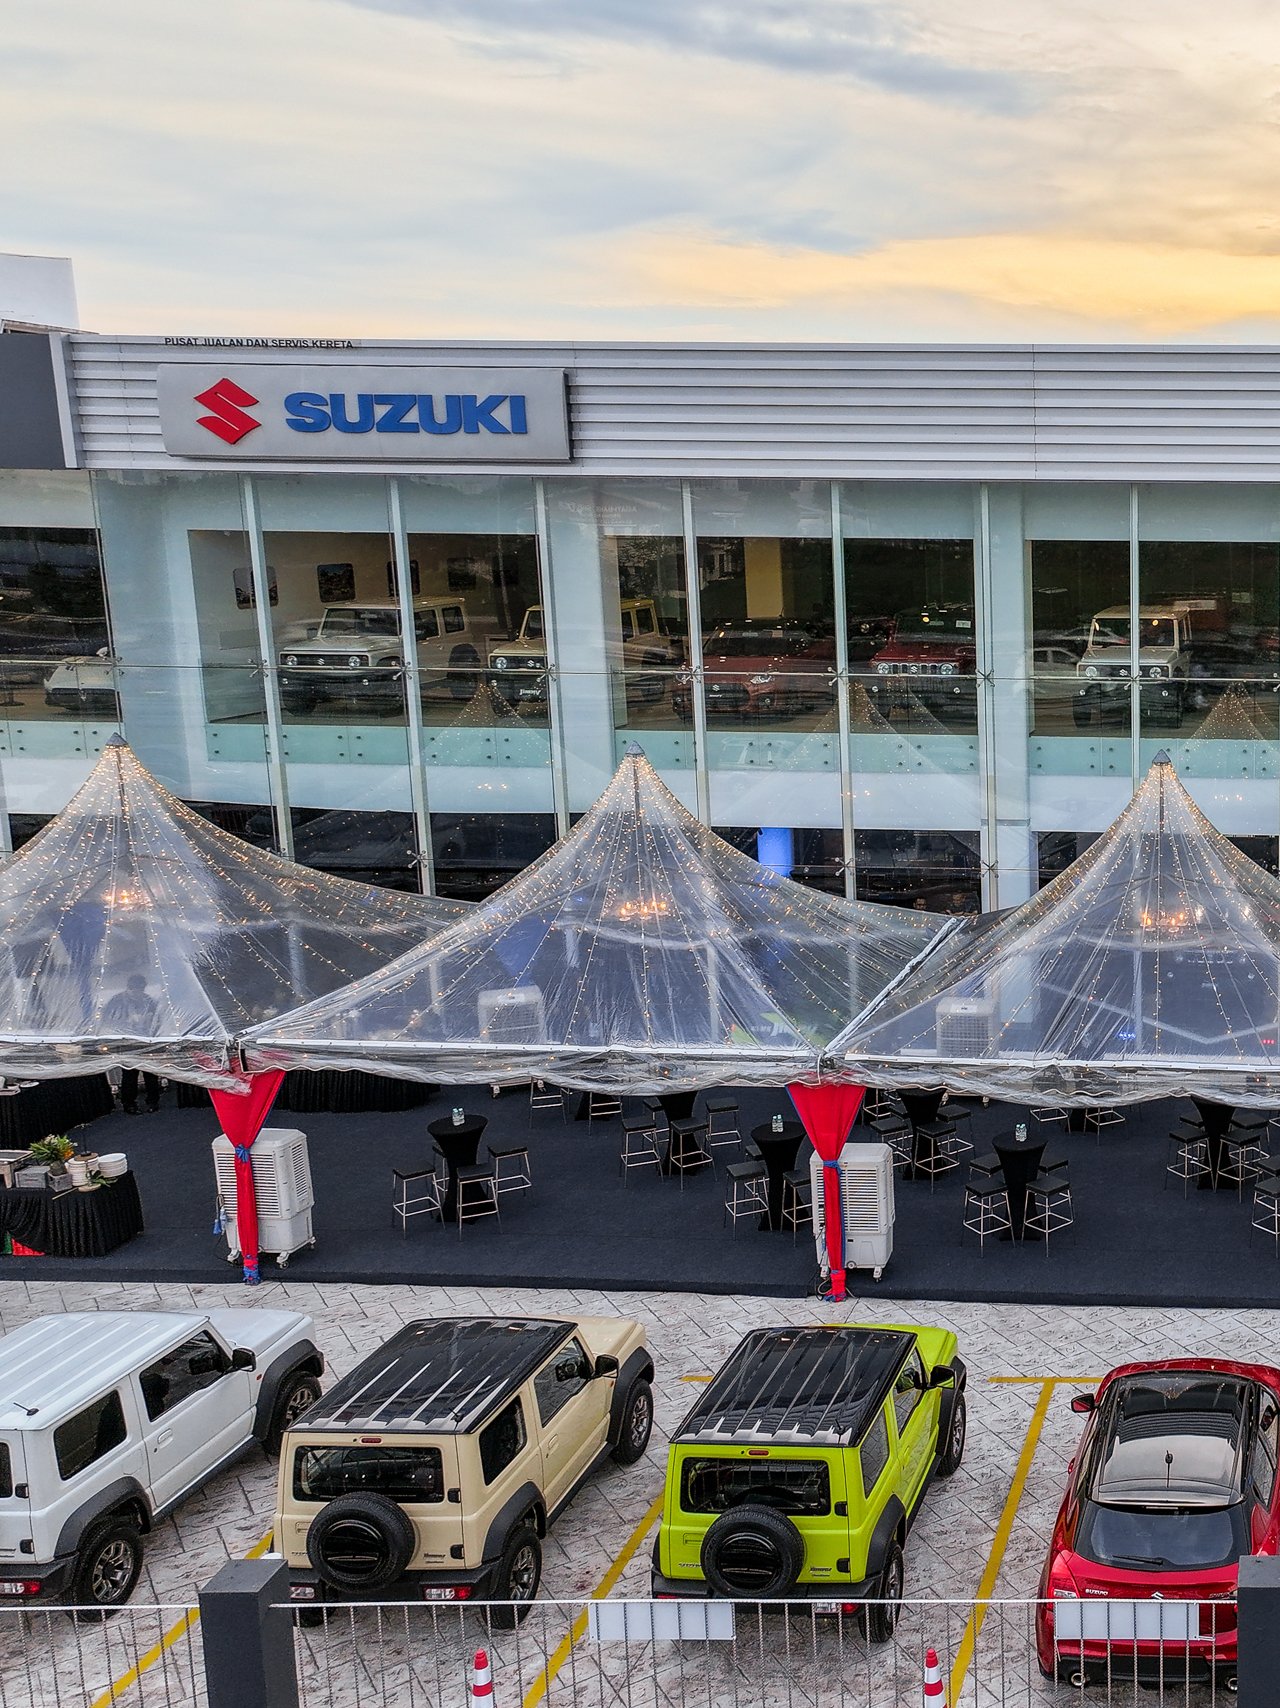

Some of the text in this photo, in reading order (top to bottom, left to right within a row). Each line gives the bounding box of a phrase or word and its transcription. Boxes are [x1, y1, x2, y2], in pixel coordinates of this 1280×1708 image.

[164, 337, 354, 349] PUSAT JUALAN DAN SERVIS KERETA
[284, 391, 529, 435] SUZUKI
